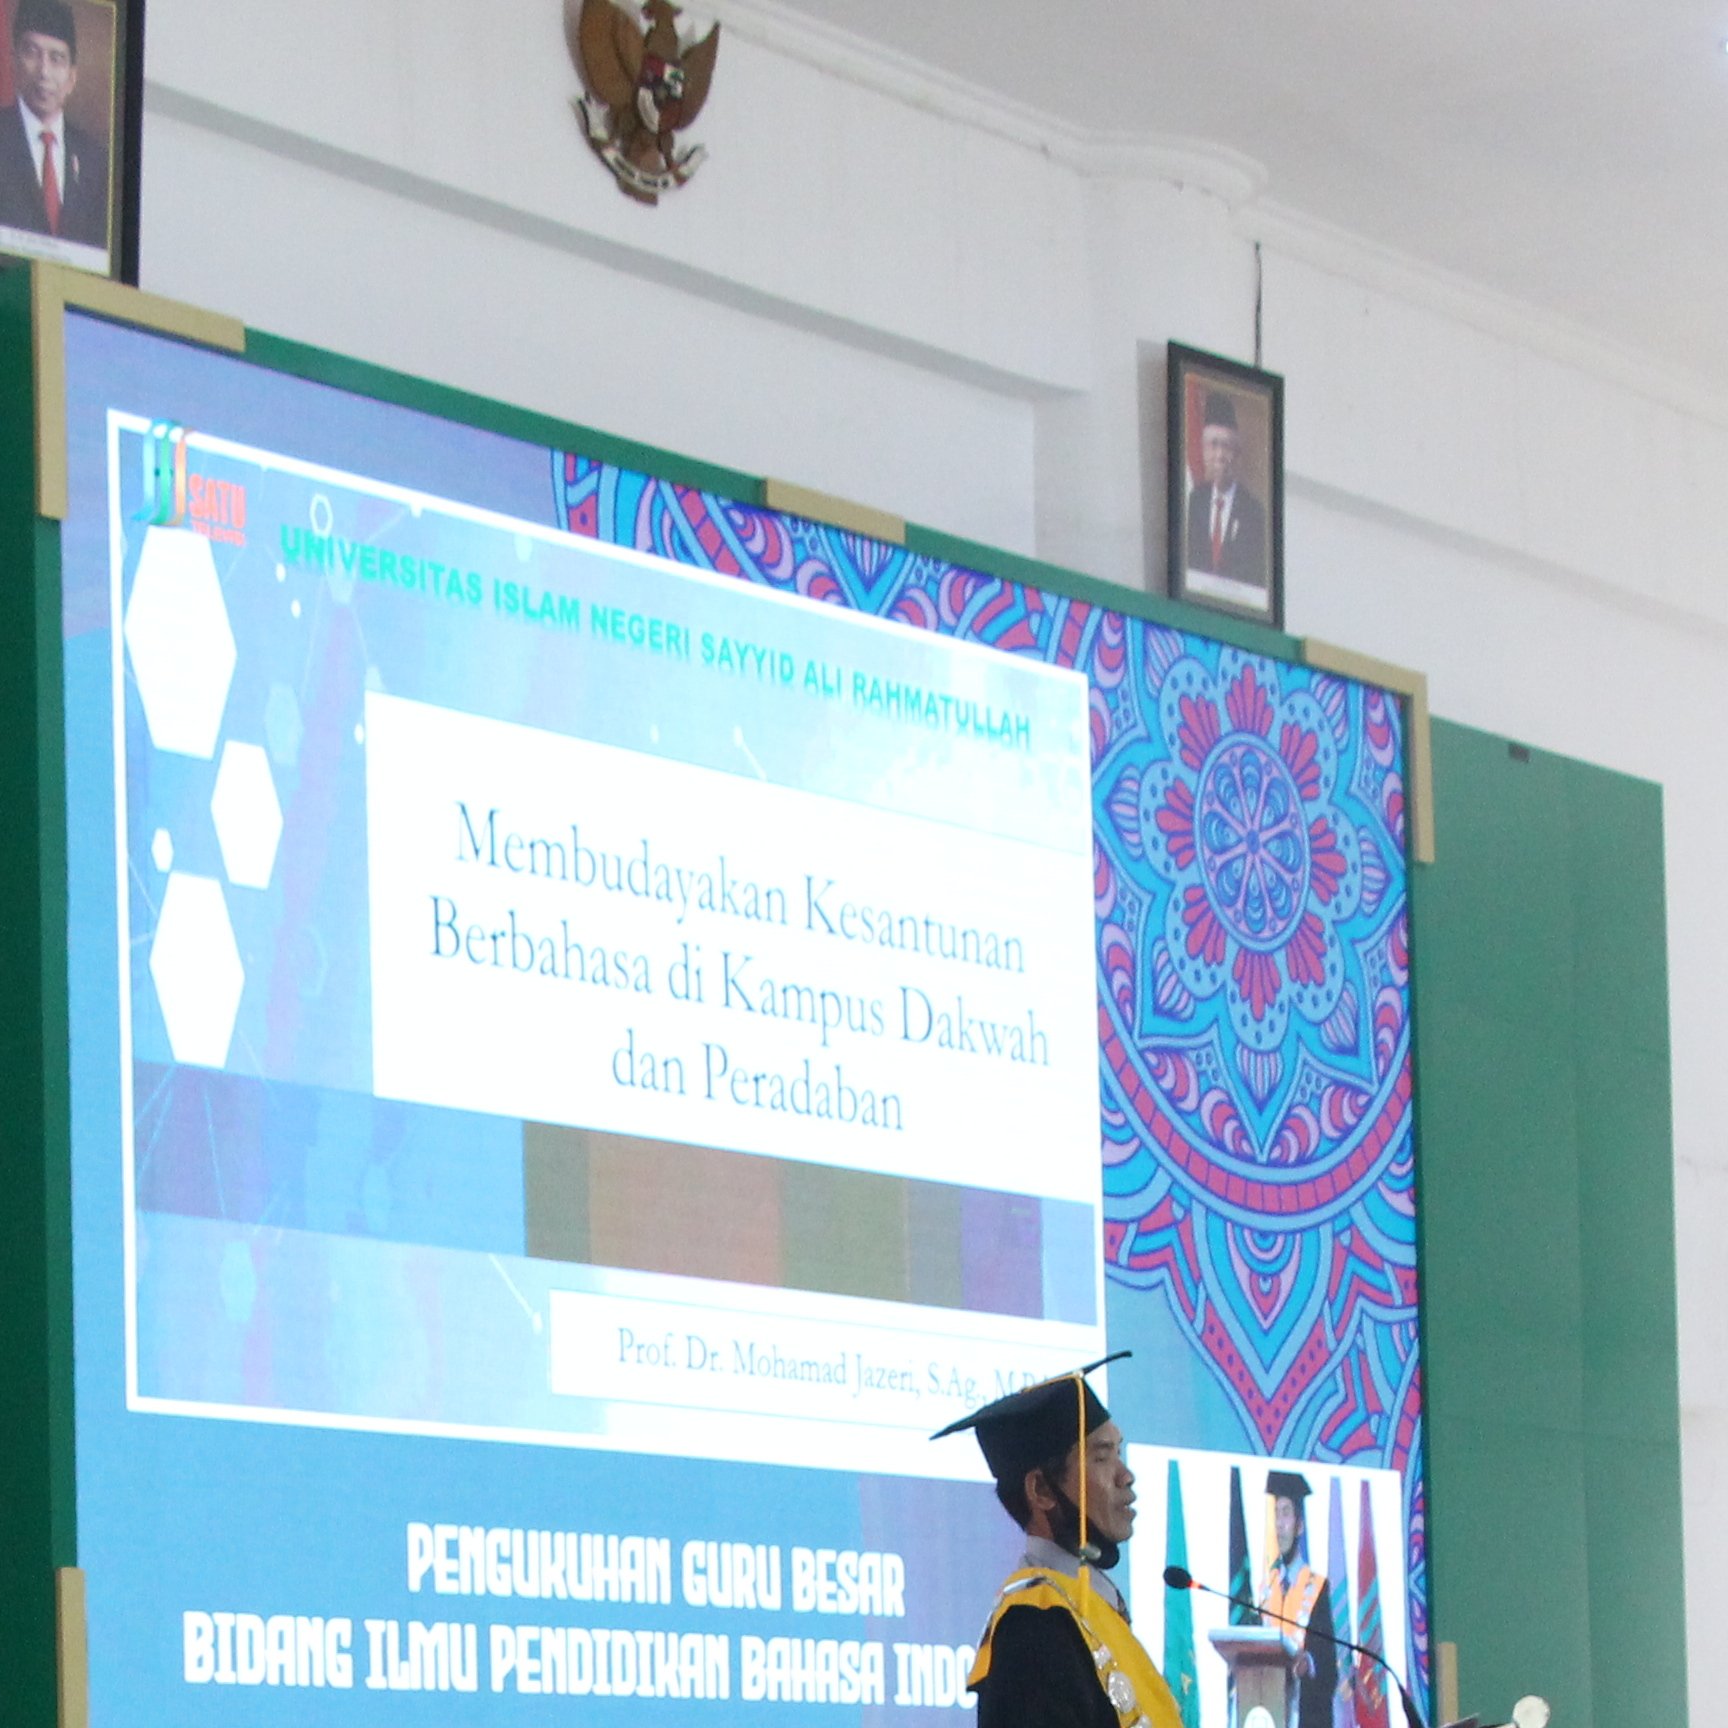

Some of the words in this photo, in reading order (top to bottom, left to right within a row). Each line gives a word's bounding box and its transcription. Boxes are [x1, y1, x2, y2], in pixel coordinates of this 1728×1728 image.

[187, 473, 247, 530] SATU
[279, 523, 484, 605] UNIVERSITAS
[493, 577, 581, 628] ISLAM
[591, 603, 691, 658] NEGERI
[701, 633, 795, 684] SAYYID
[804, 664, 843, 699] ALI
[852, 672, 1031, 750] RAHMATULLAH
[453, 800, 789, 926] Membudayakan
[804, 874, 1025, 974] Kesantunan
[429, 895, 654, 995] Berbahasa
[668, 942, 704, 1003] di
[722, 950, 886, 1048] Kampus
[898, 985, 1051, 1066] Dakwah
[611, 1027, 686, 1095] dan
[702, 1042, 904, 1131] Peradaban
[617, 1327, 677, 1367] Prof.
[685, 1335, 724, 1374] Dr.
[731, 1340, 848, 1386] Mohamad
[406, 1521, 672, 1605] PENGUKUHAN
[681, 1539, 782, 1611] GURU
[791, 1546, 907, 1618] BESAR
[182, 1610, 354, 1689] BIDANG
[363, 1618, 479, 1693] ILMU
[488, 1623, 731, 1700] PENDIDIKAN
[740, 1634, 886, 1706] BAHASA
